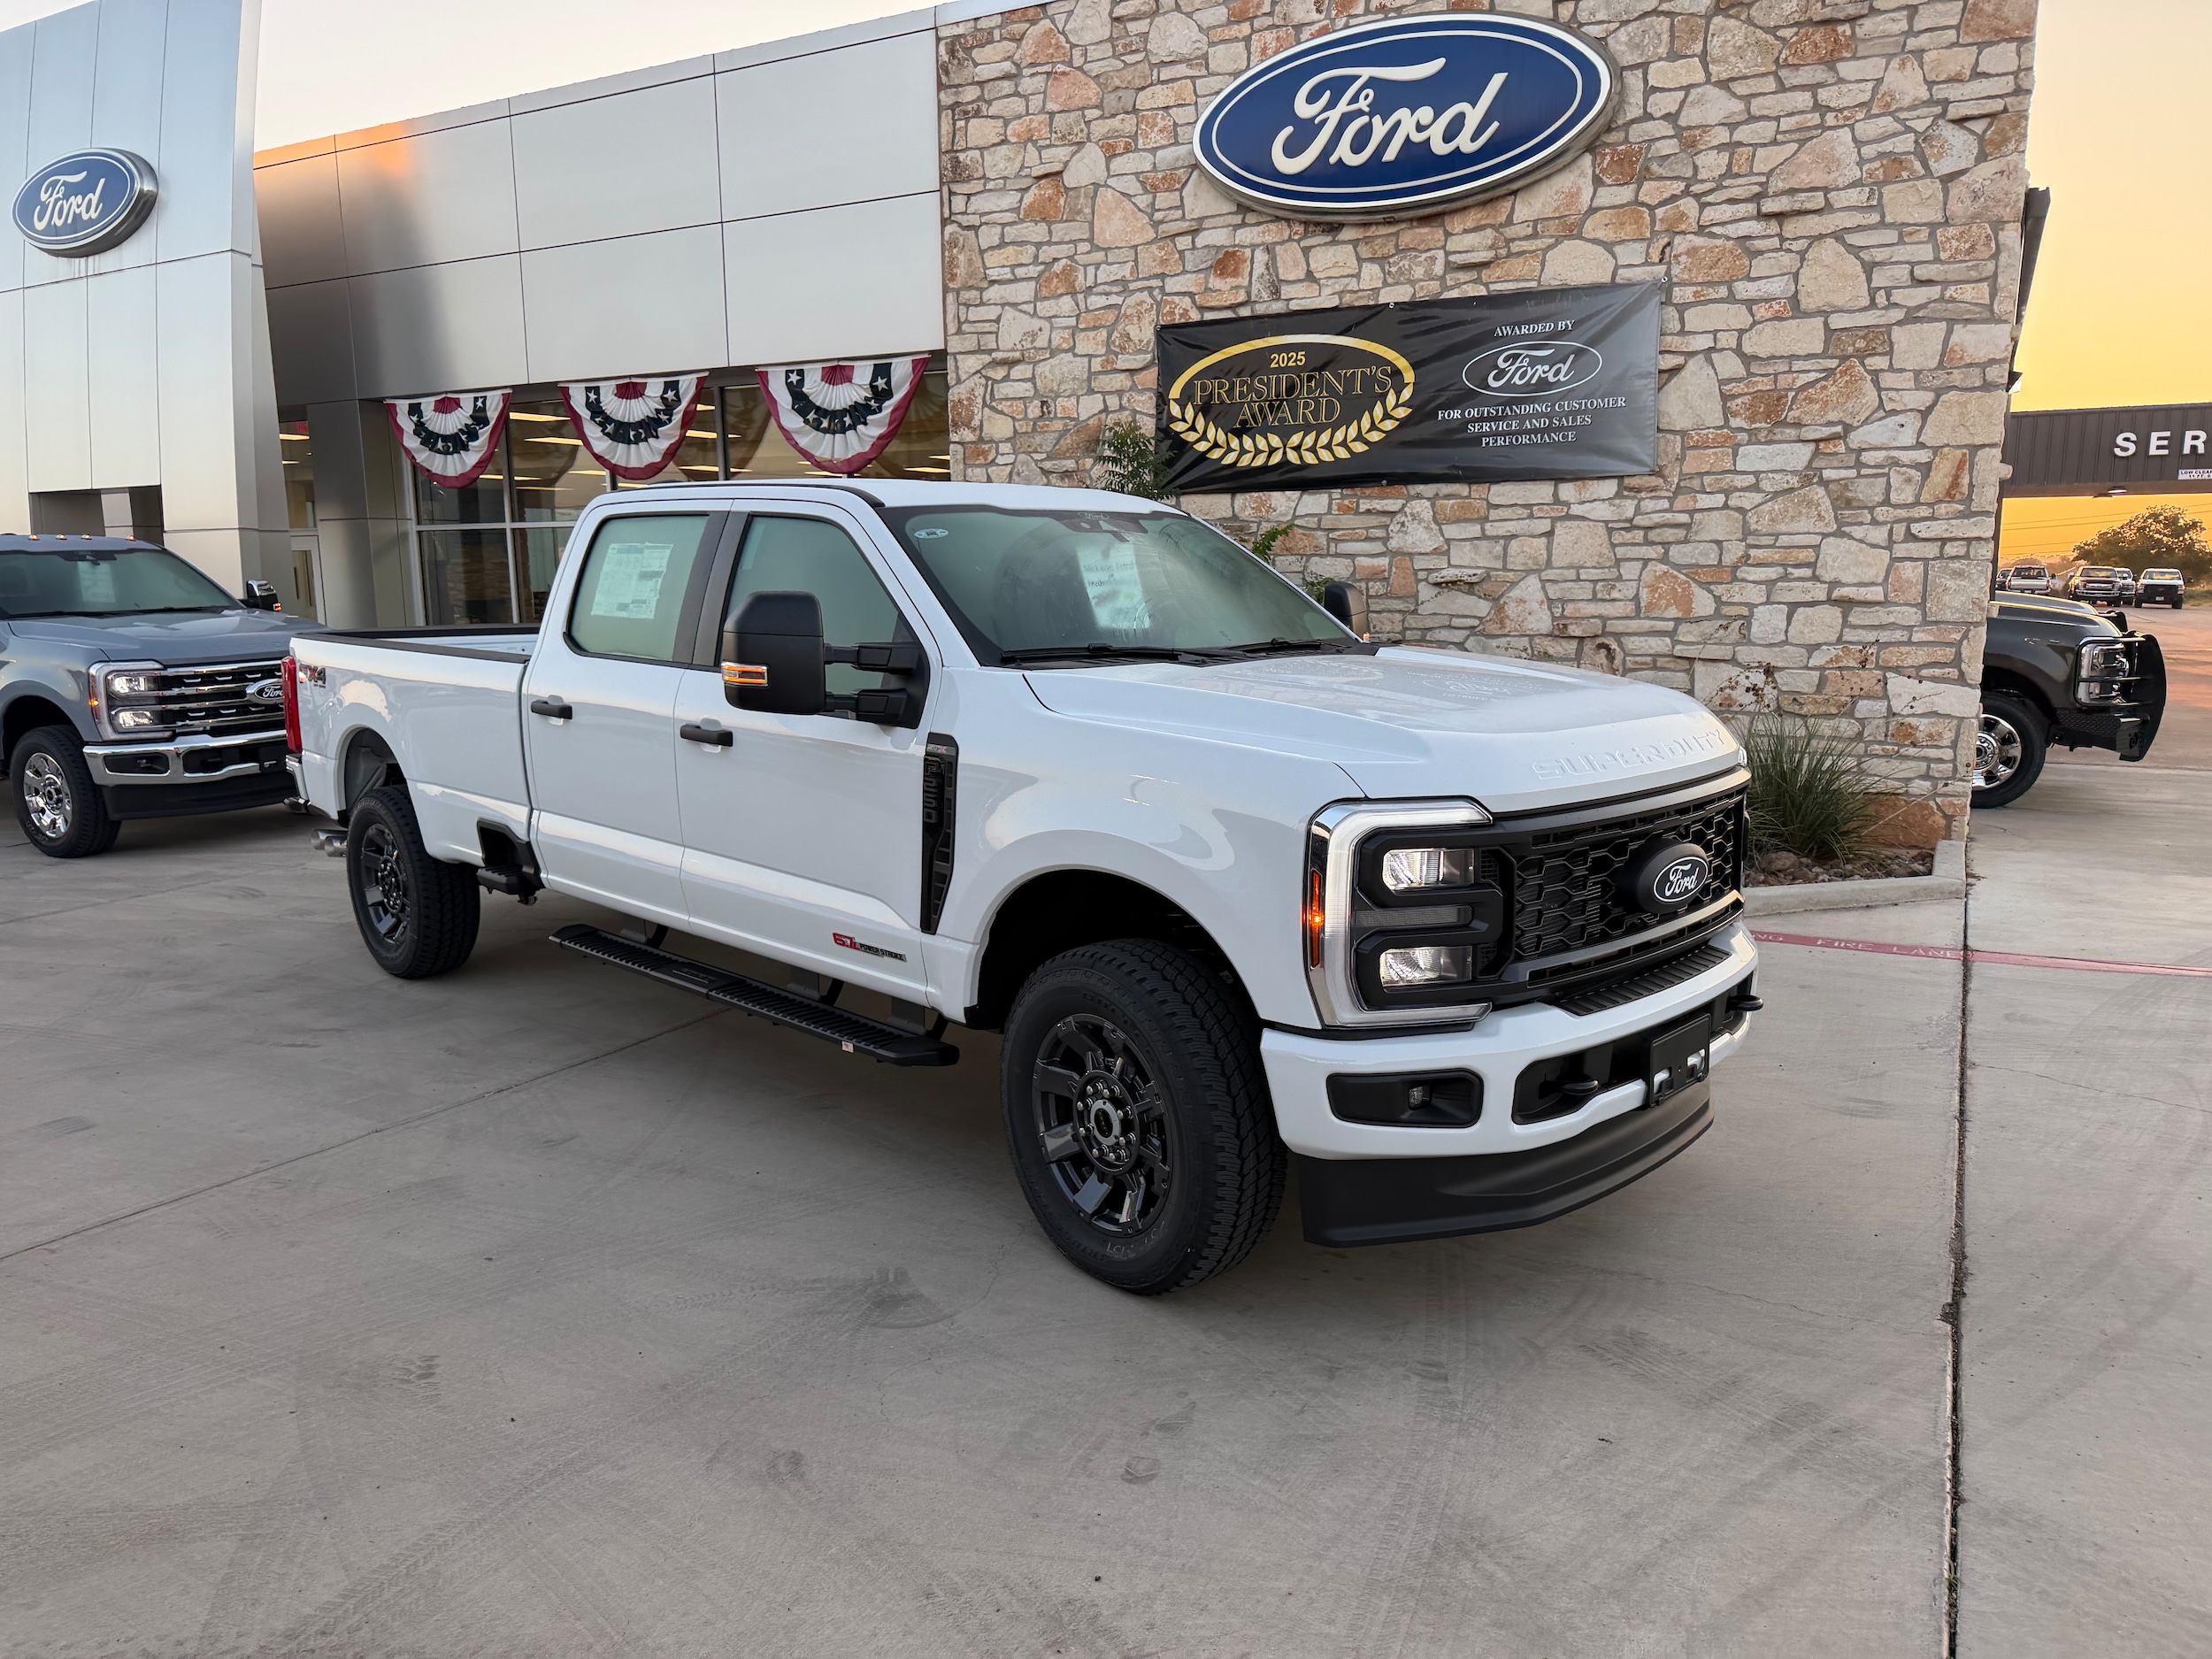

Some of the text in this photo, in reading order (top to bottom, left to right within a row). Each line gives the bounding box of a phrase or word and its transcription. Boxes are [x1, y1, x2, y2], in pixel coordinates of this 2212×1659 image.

[1271, 58, 1509, 175] Ford
[34, 171, 105, 231] Ford
[1494, 319, 1575, 337] AWARDED BY
[1270, 351, 1306, 368] 2025
[1487, 349, 1575, 388] Ford
[1193, 365, 1393, 404] PRESIDENT'S
[1233, 396, 1341, 428] AWARD
[1437, 396, 1626, 420] FOR OUTSTANDING CUSTOMER
[1467, 415, 1592, 433] SERVICE AND SALES
[1481, 431, 1577, 447] PERFORMANCE
[1532, 729, 1726, 780] SUPER DUTY
[1664, 863, 1699, 896] Ford
[859, 943, 880, 954] POWER
[880, 949, 904, 962] STROKE
[1816, 939, 1956, 957] FIRE LANE
